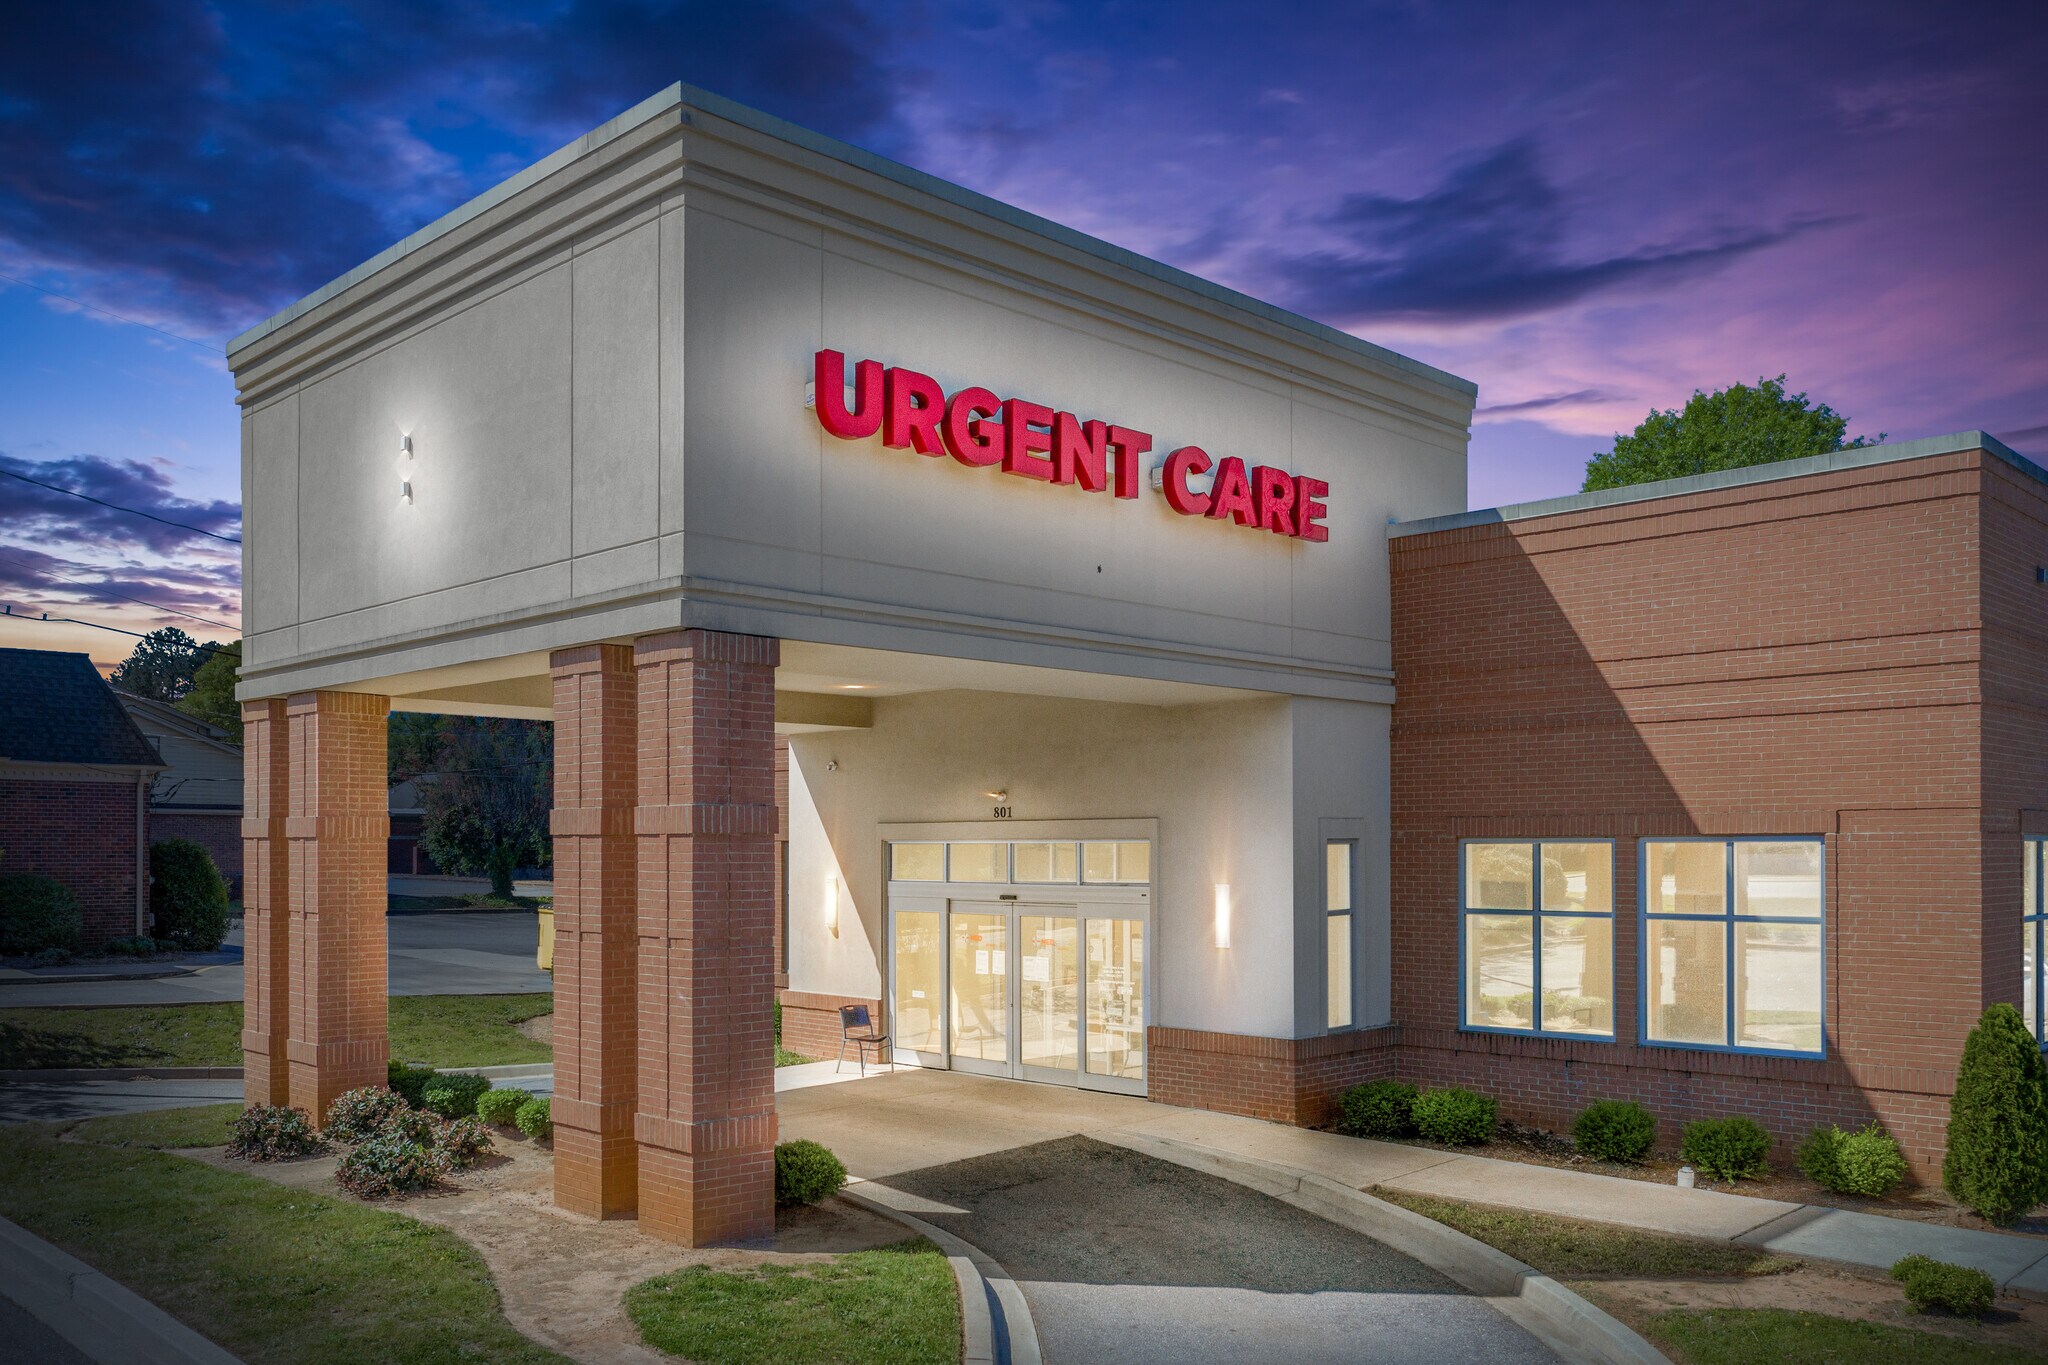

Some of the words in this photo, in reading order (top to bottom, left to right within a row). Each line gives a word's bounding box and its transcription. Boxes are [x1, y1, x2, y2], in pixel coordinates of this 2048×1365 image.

[815, 349, 1152, 499] URGENT
[1162, 446, 1329, 542] CARE
[993, 806, 1013, 818] 801
